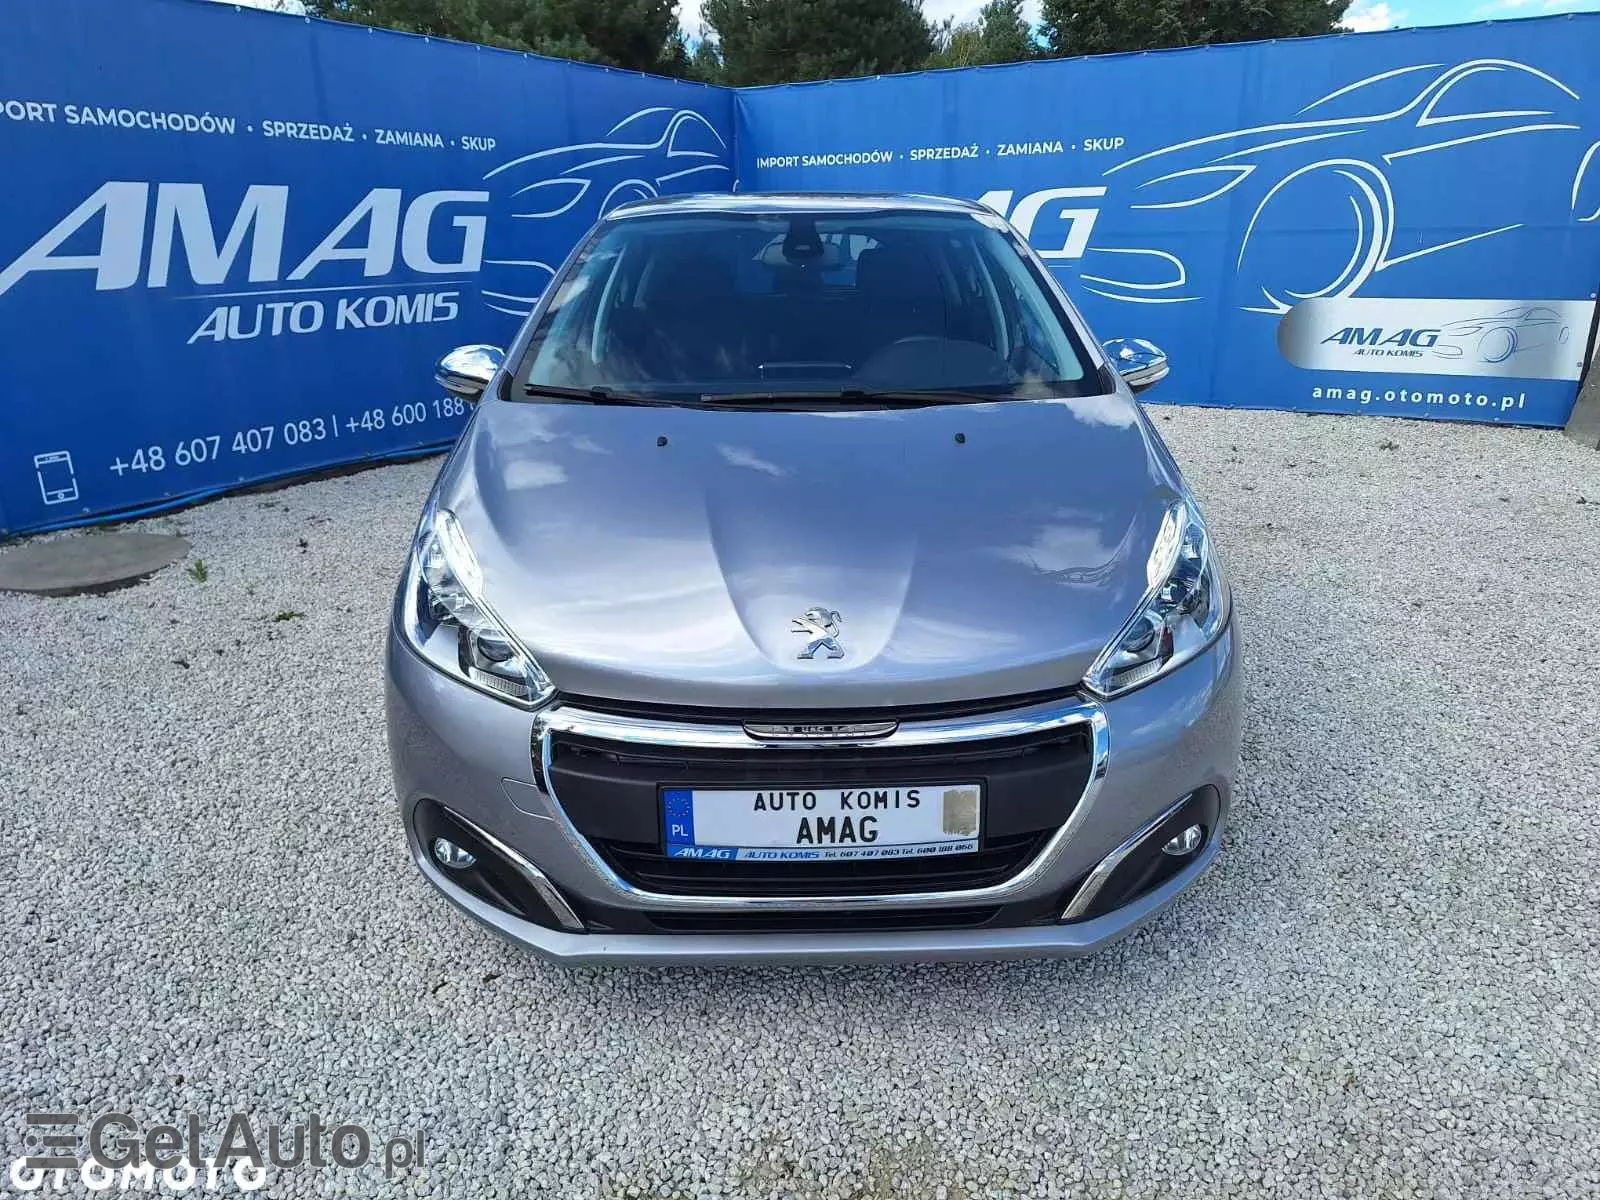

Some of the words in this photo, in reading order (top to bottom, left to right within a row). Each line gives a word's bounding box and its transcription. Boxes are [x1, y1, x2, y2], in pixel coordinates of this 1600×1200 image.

[0, 100, 57, 123] ORT
[64, 104, 236, 135] SAMOCHODÓW
[262, 120, 355, 142] SPRZEDAŻ
[374, 128, 444, 148] ZAMIANA
[461, 136, 496, 151] SKUP
[757, 155, 800, 169] IMPORT
[801, 149, 893, 167] SAMOCHODÓW
[910, 144, 979, 161] SPRZEDAŻ
[997, 141, 1063, 156] ZAMIANA
[1083, 137, 1125, 151] SKUP
[187, 300, 324, 344] AUTO
[335, 291, 459, 330] KOMIS
[1320, 327, 1442, 347] AMAG
[1353, 348, 1385, 356] AUTO
[1386, 349, 1423, 357] KOMIS
[1312, 385, 1526, 409] amag.otomoto.pl
[110, 446, 166, 476] +48
[175, 435, 221, 466] 607
[231, 426, 274, 454] 407
[283, 419, 326, 445] 083
[346, 408, 385, 433] +48
[391, 402, 426, 426] 600
[433, 396, 464, 419] 188
[753, 792, 817, 811] AUTO
[841, 789, 921, 810] KOMIS
[671, 824, 689, 837] PL
[796, 816, 878, 844] AMAG
[674, 847, 731, 859] AMAG
[744, 851, 777, 859] AUTO
[779, 851, 821, 859] KOMIS
